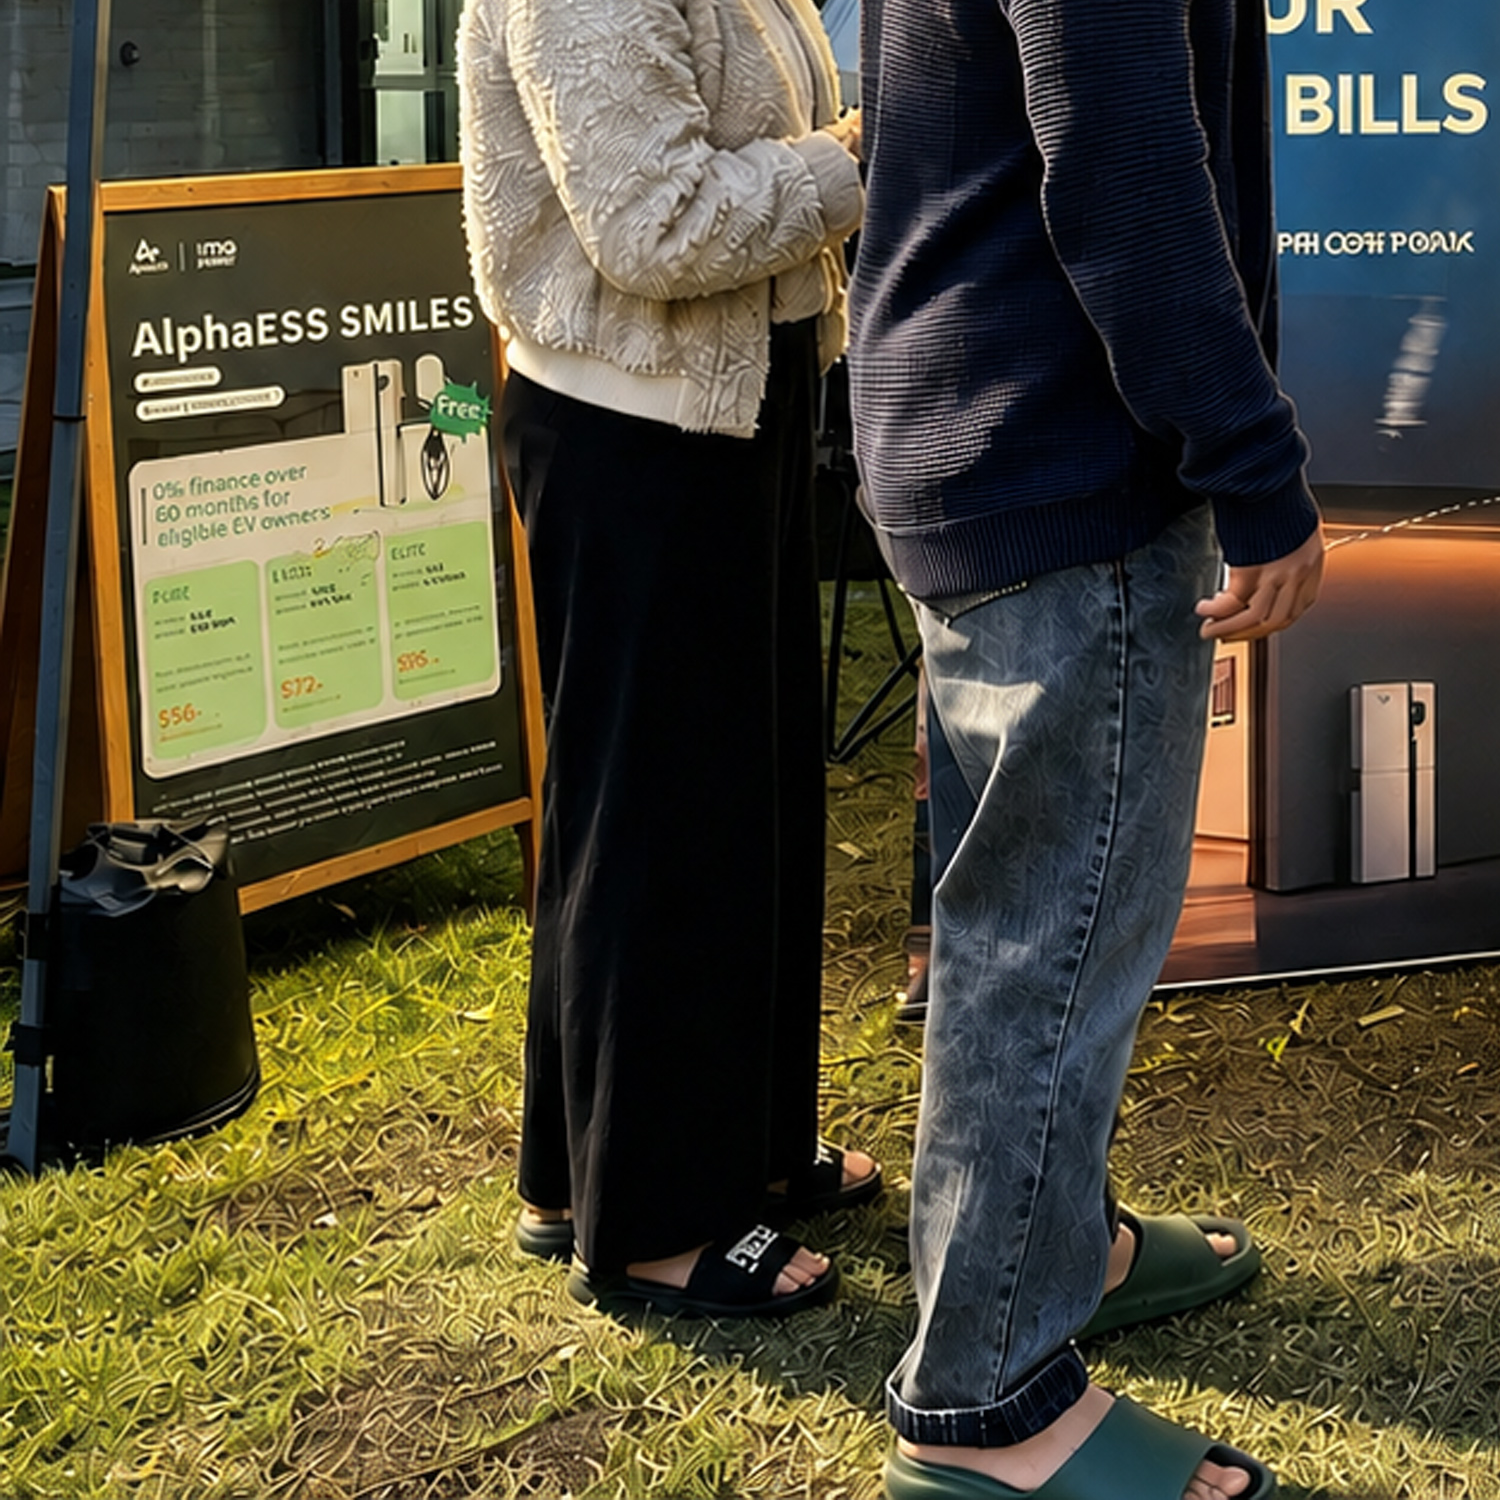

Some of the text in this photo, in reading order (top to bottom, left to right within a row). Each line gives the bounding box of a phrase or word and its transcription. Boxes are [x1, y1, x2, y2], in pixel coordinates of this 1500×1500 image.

[1286, 73, 1488, 135] BILLS
[132, 296, 475, 364] AlphaESS SMILES
[189, 473, 262, 497] finance
[264, 465, 308, 485] over
[185, 493, 260, 519] months
[263, 489, 291, 508] for
[232, 515, 257, 536] EV
[260, 505, 332, 531] owners
